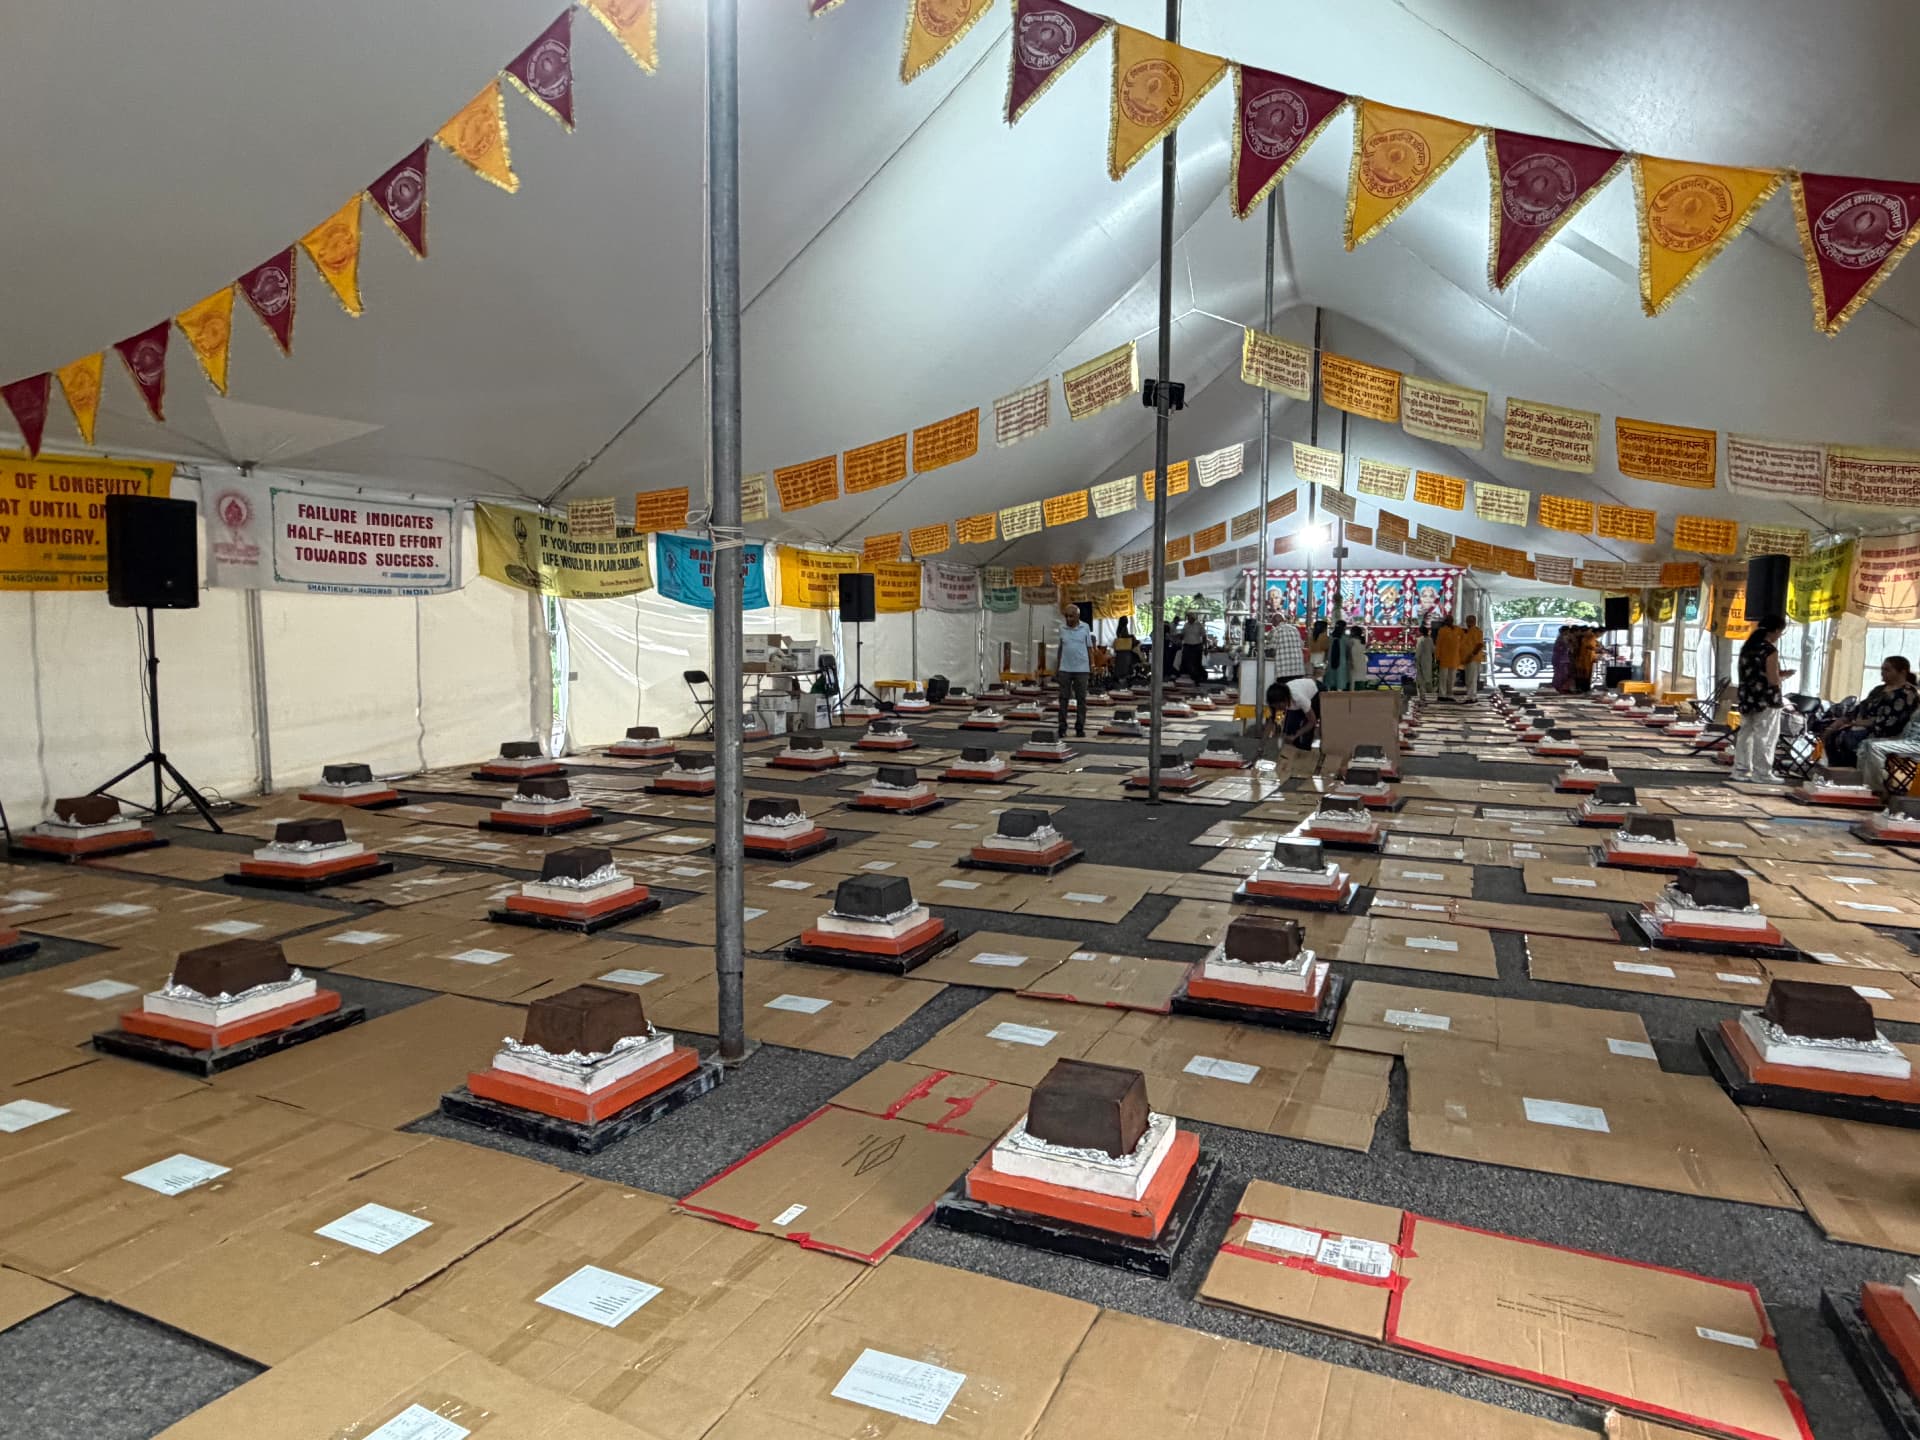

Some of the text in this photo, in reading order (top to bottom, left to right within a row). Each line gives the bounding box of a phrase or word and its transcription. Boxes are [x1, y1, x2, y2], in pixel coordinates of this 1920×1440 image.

[15, 472, 142, 495] OF LONGEVITY
[30, 500, 82, 518] UNTIL
[298, 504, 434, 530] FAILURE INDICATES
[24, 526, 100, 544] HUNGRY.
[539, 517, 556, 532] TRY
[558, 521, 568, 534] TO
[287, 524, 442, 549] HALF-HEARTED EFFORT
[540, 535, 547, 547] IF
[550, 537, 568, 550] YOU
[568, 540, 596, 554] SUCCEED
[296, 546, 439, 568] TOWARDS SUCCESS.
[542, 552, 559, 566] LIFE
[560, 556, 584, 570] WOULD
